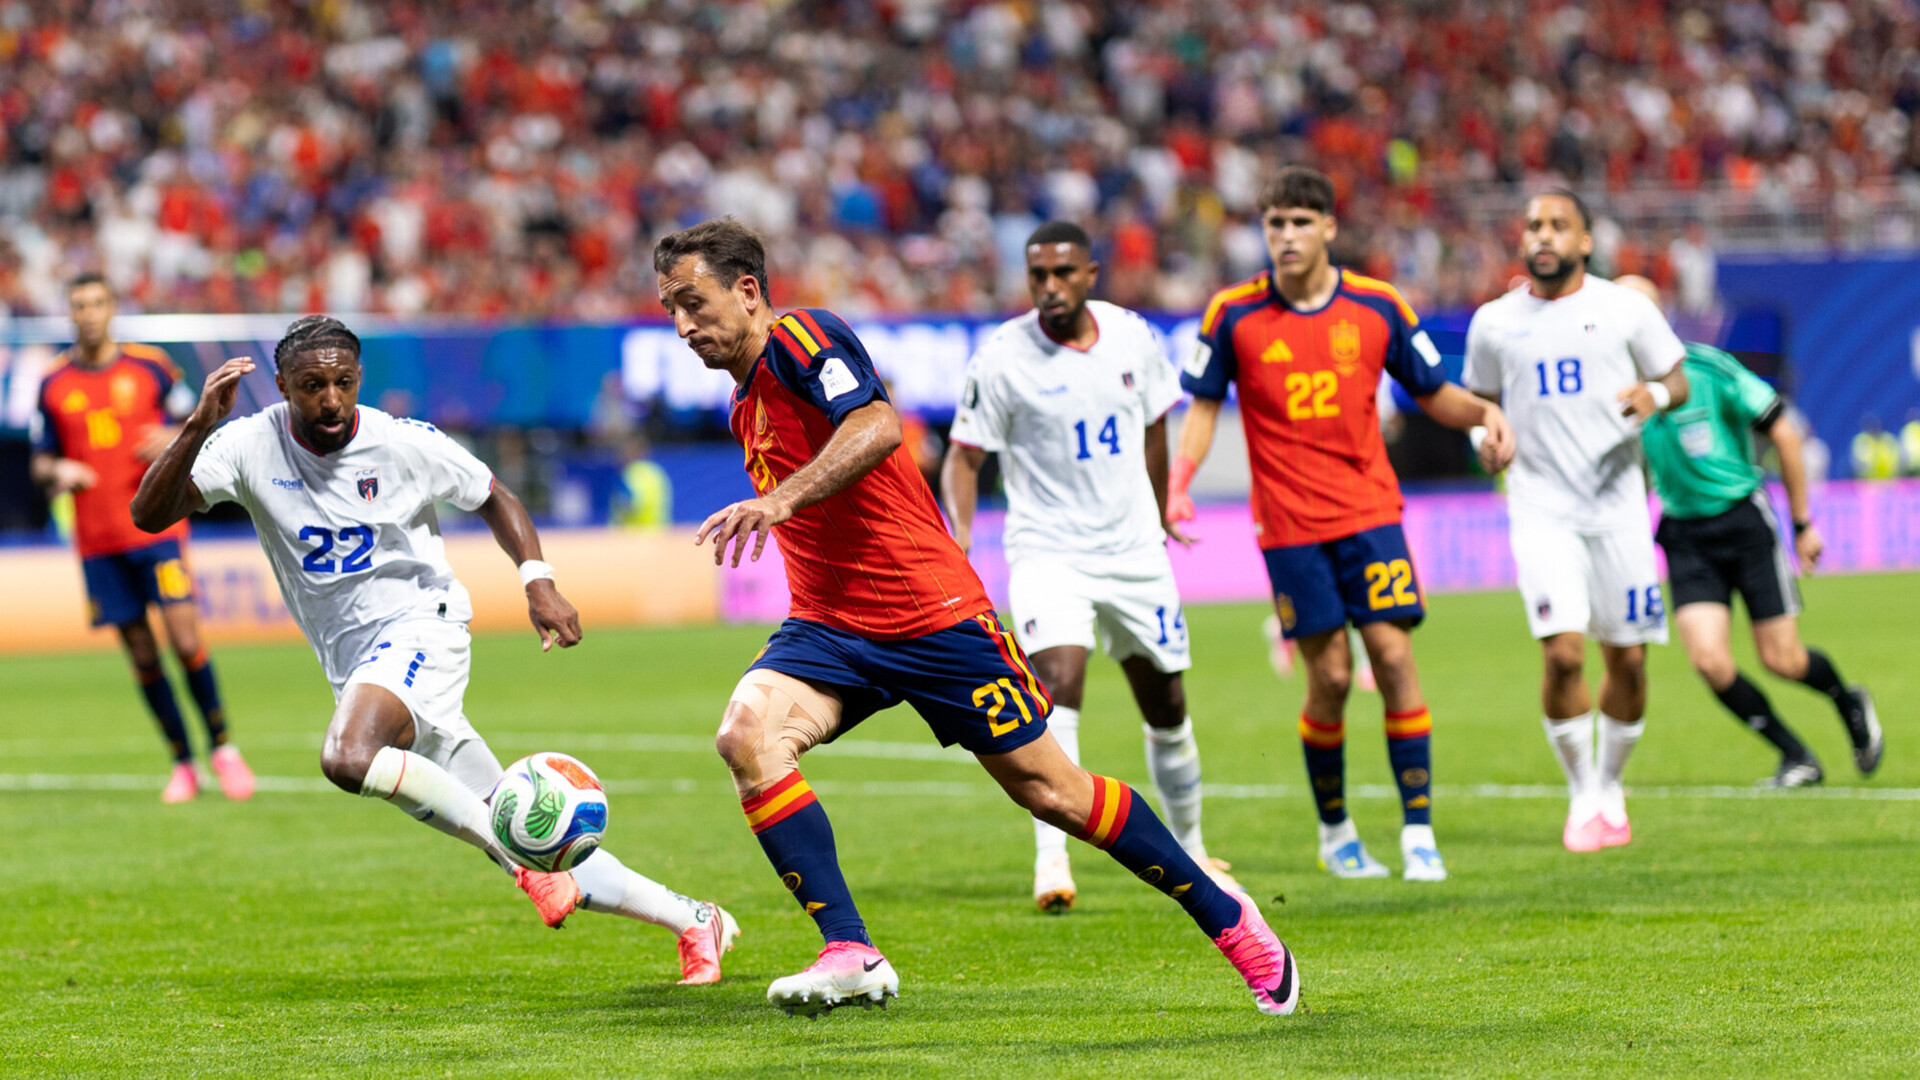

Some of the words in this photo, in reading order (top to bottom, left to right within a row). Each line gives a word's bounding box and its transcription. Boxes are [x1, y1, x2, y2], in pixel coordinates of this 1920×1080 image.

[1285, 371, 1340, 420] 22
[1537, 359, 1582, 396] 18
[85, 408, 122, 448] 16
[1074, 415, 1120, 459] 14
[299, 525, 374, 573] 22
[155, 559, 192, 598] 16
[1364, 559, 1417, 611] 22
[1627, 585, 1663, 621] 18
[972, 677, 1033, 737] 21
